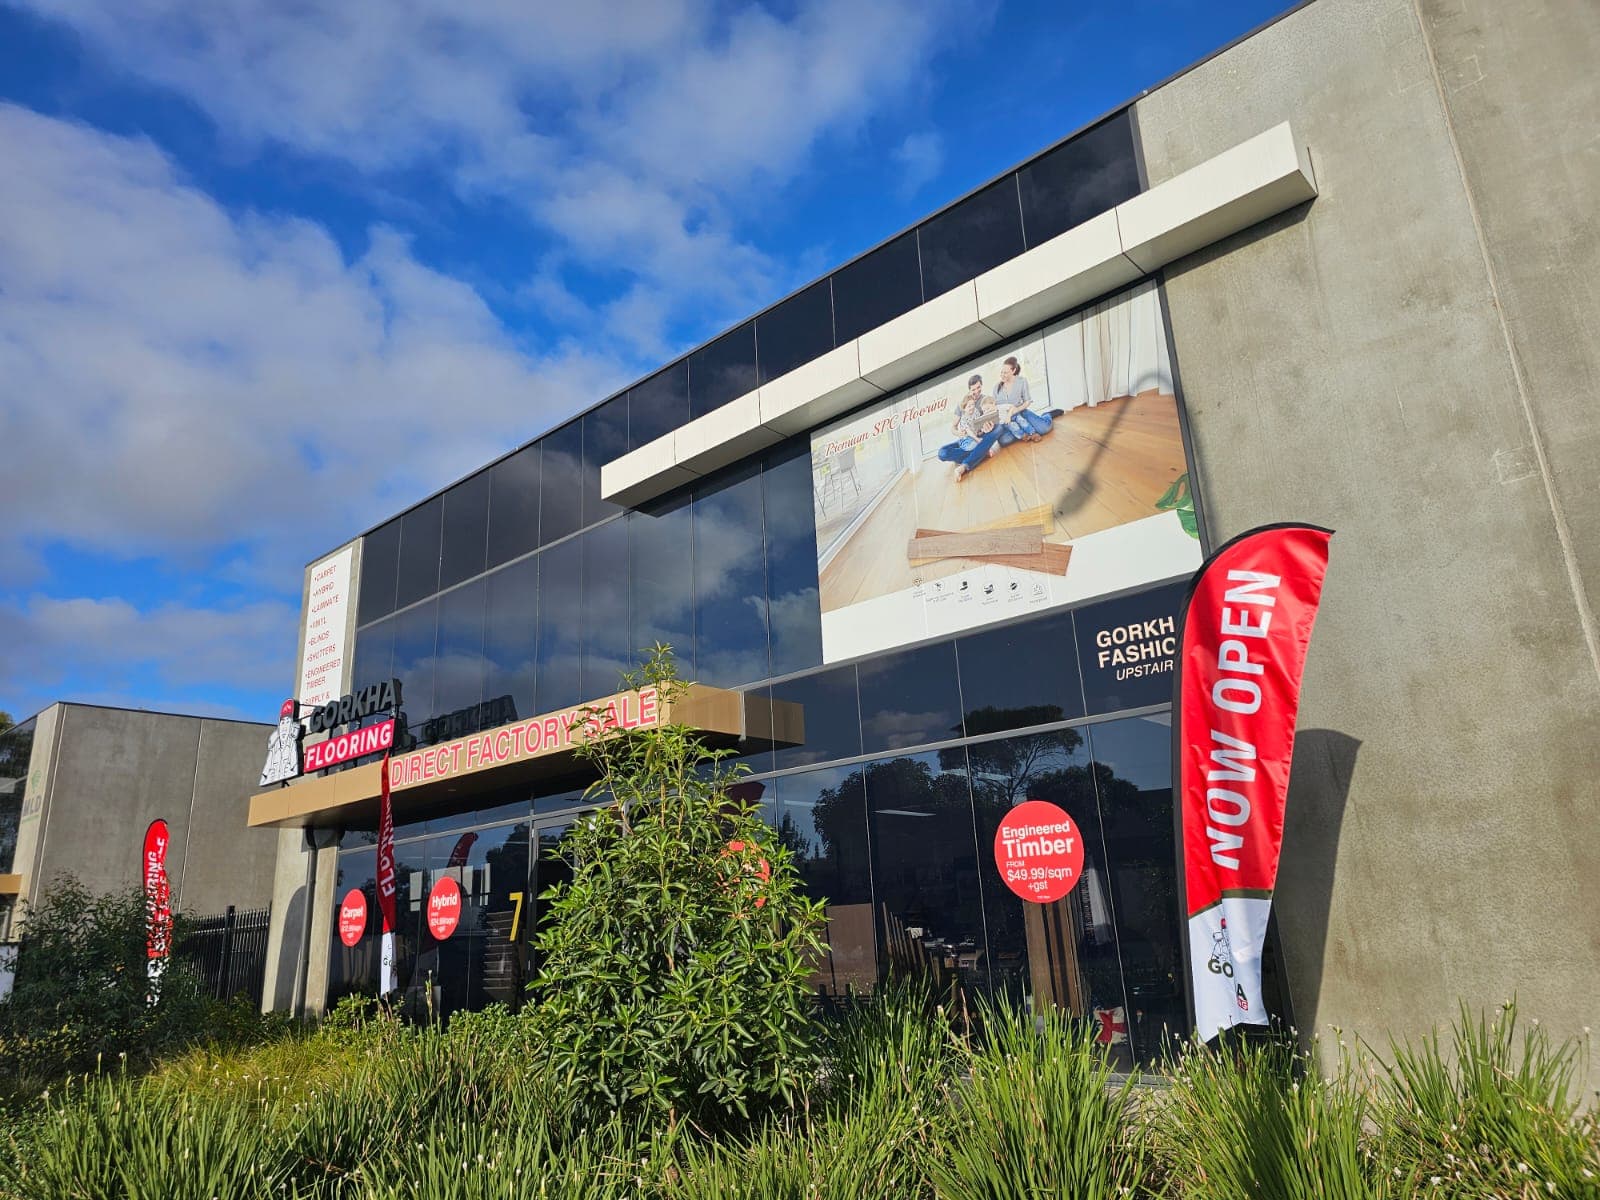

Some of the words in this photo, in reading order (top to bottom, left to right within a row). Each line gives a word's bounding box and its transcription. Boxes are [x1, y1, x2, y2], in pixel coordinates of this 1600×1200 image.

[825, 431, 870, 457] Premium
[872, 414, 899, 437] SPC
[902, 397, 949, 424] Flooring
[316, 564, 337, 581] CARPET
[310, 630, 330, 646] BLINDS
[1096, 616, 1175, 648] GORKH
[1212, 569, 1282, 715] OPEN
[309, 643, 336, 662] SHUTTERS
[307, 658, 341, 679] ENGINEERED
[1116, 660, 1174, 681] UPSTAIR
[310, 678, 398, 733] GORKHA
[306, 723, 392, 769] FLOORING
[390, 743, 463, 788] DIRECT
[465, 710, 578, 769] FACTORY
[584, 688, 657, 739] SALE
[1206, 729, 1257, 871] NOW
[1002, 820, 1070, 839] Engineered
[1002, 836, 1074, 859] Timber
[1007, 867, 1073, 882] $49.99/sqm
[1028, 881, 1048, 892] +gst
[432, 893, 457, 911] Hybrid
[342, 905, 364, 921] Carpet
[509, 892, 523, 941] 7
